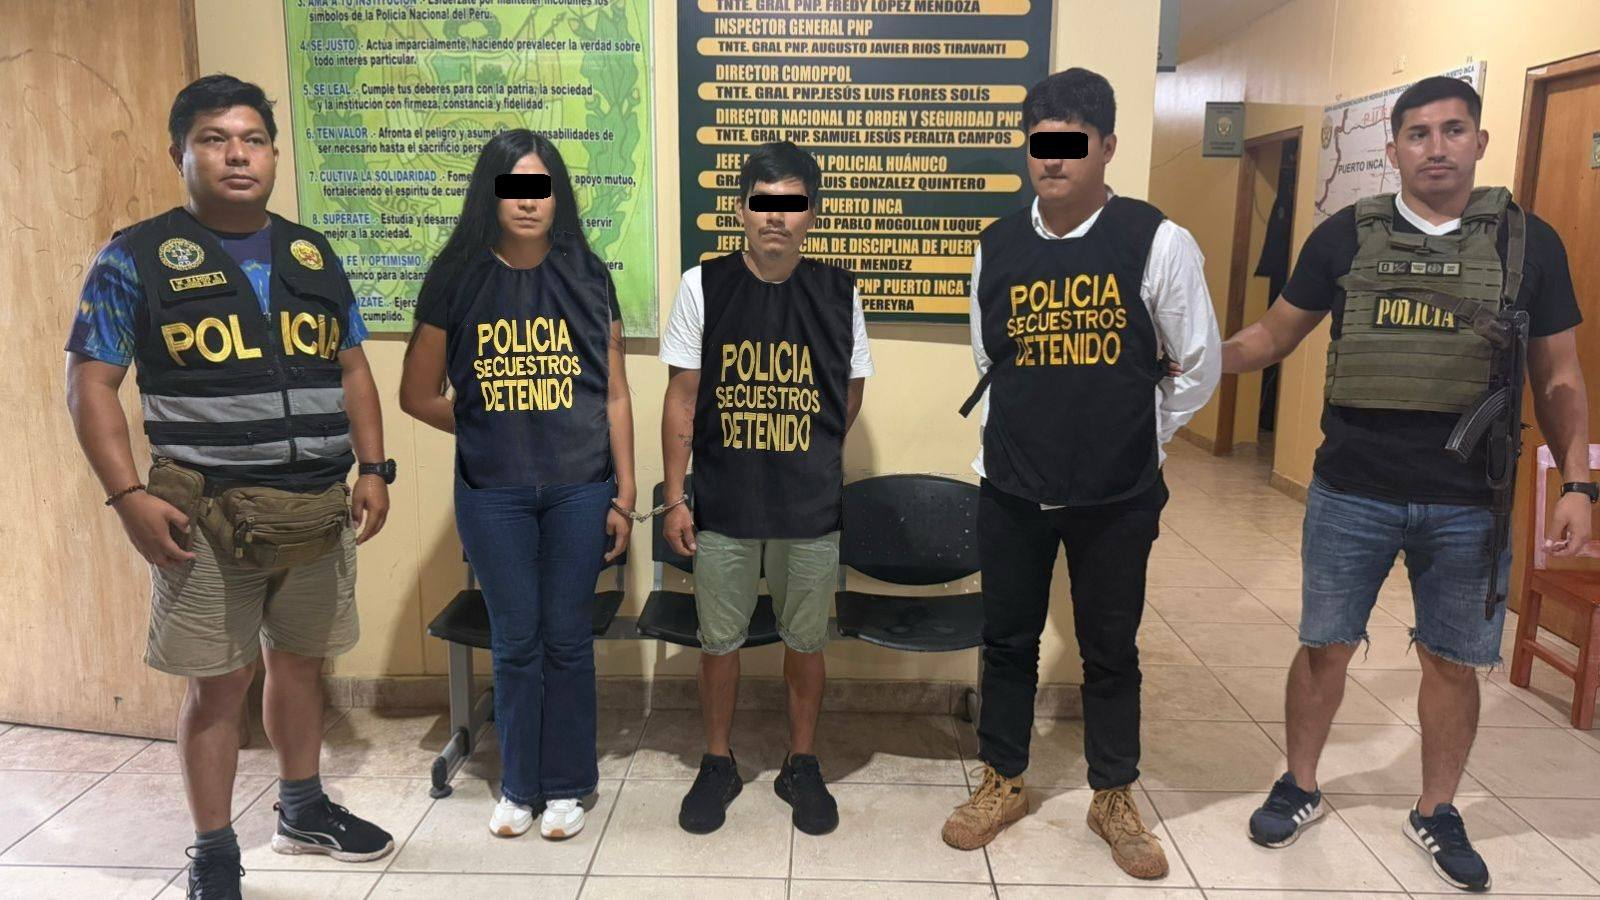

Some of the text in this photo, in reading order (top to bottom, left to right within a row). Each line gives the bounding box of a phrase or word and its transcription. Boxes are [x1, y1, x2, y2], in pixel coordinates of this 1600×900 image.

[352, 9, 362, 20] de
[366, 9, 374, 20] la
[409, 8, 449, 20] Nacional
[452, 8, 466, 19] del
[825, 0, 867, 12] FREDY
[914, 0, 980, 13] MENDOZA
[715, 18, 873, 36] INSPECTOR GENERAL PNP
[311, 40, 323, 51] SE
[325, 39, 354, 51] JUSTO
[395, 38, 470, 52] imparcialmente,
[472, 38, 513, 50] haciendo
[517, 39, 565, 53] prevalecer
[569, 39, 577, 50] la
[580, 39, 612, 51] verdad
[615, 39, 641, 51] sobre
[718, 41, 1006, 54] TNTE. GRAL PNP. AUGUSTO JAVIER RIOS TIRAVANTI
[314, 55, 333, 66] todo
[371, 54, 416, 68] particular.
[715, 64, 852, 82] DIRECTOR COMOPPOL
[314, 84, 326, 95] SE
[328, 84, 350, 95] LEAL
[361, 83, 395, 96] Cumple
[397, 84, 411, 95] tus
[414, 83, 450, 95] deberes
[454, 85, 474, 96] para
[477, 85, 493, 95] con
[496, 84, 504, 95] la
[508, 84, 537, 97] patria,
[540, 84, 548, 95] la
[551, 84, 593, 95] sociedad
[716, 86, 751, 99] TNTE.
[755, 87, 789, 100] GRAL
[865, 88, 895, 100] LUIS
[898, 88, 947, 100] FLORES
[950, 86, 990, 101] SOLÍS
[325, 99, 334, 110] la
[385, 100, 402, 109] con
[404, 99, 440, 110] firmeza,
[443, 99, 493, 109] constancia
[504, 99, 543, 109] fidelidad
[715, 108, 1023, 127] DIRECTOR NACIONAL DE ORDEN Y SEGURIDAD PNP
[317, 128, 335, 139] TEN
[337, 128, 367, 138] VALOR
[378, 127, 412, 139] Afronta
[414, 127, 423, 138] el
[426, 127, 456, 141] peligro
[459, 129, 465, 139] y
[467, 129, 496, 139] asume
[603, 129, 613, 141] de
[716, 129, 1011, 144] TNTE. GRAL PNP. SAMUEL JESÚS PERALTA CAMPOS
[318, 142, 460, 154] ser necesario hasta el sacrificio
[716, 153, 741, 170] JEFE
[828, 155, 883, 172] POLICIAL
[886, 152, 947, 172] HUÁNUCO
[1338, 159, 1383, 175] PUERTO INCA
[320, 171, 358, 182] CULTIVA
[361, 171, 373, 182] LA
[375, 171, 437, 181] SOLIDARIDAD
[575, 174, 602, 186] apoyo
[605, 173, 636, 187] mutuo,
[850, 177, 915, 189] GONZALEZ
[918, 177, 986, 191] QUINTERO
[323, 186, 381, 197] fortaleciendo
[384, 186, 393, 196] el
[432, 186, 442, 196] de
[822, 198, 903, 214] PUERTO INCA
[381, 213, 414, 224] Estudia
[416, 216, 422, 227] y
[586, 217, 612, 227] servir
[834, 218, 872, 230] PABLO
[875, 219, 940, 231] MOGOLLON
[943, 220, 981, 232] LUQUE
[324, 228, 412, 241] mejor a la sociedad.
[717, 235, 742, 251] JEFE
[832, 238, 981, 255] DE DISCIPLINA DE PUERT
[347, 256, 358, 266] FE
[360, 256, 366, 266] Y
[369, 255, 421, 266] OPTIMISMO
[860, 259, 912, 271] MENDEZ
[378, 271, 397, 282] para
[857, 279, 965, 295] PNP PUERTO INCA
[1010, 273, 1121, 316] POLICIA
[862, 299, 914, 311] PEREYRA
[363, 310, 405, 323] cumplido.
[1376, 298, 1455, 328] POLICIA
[1006, 308, 1127, 338] SECUESTROS
[477, 316, 573, 356] POLICIA
[1014, 331, 1121, 366] DETENIDO
[473, 355, 582, 379] SECUESTROS
[721, 340, 814, 384] POLICIA
[481, 377, 573, 412] DETENIDO
[715, 384, 821, 414] SECUESTROS
[721, 412, 811, 452] DETENIDO
